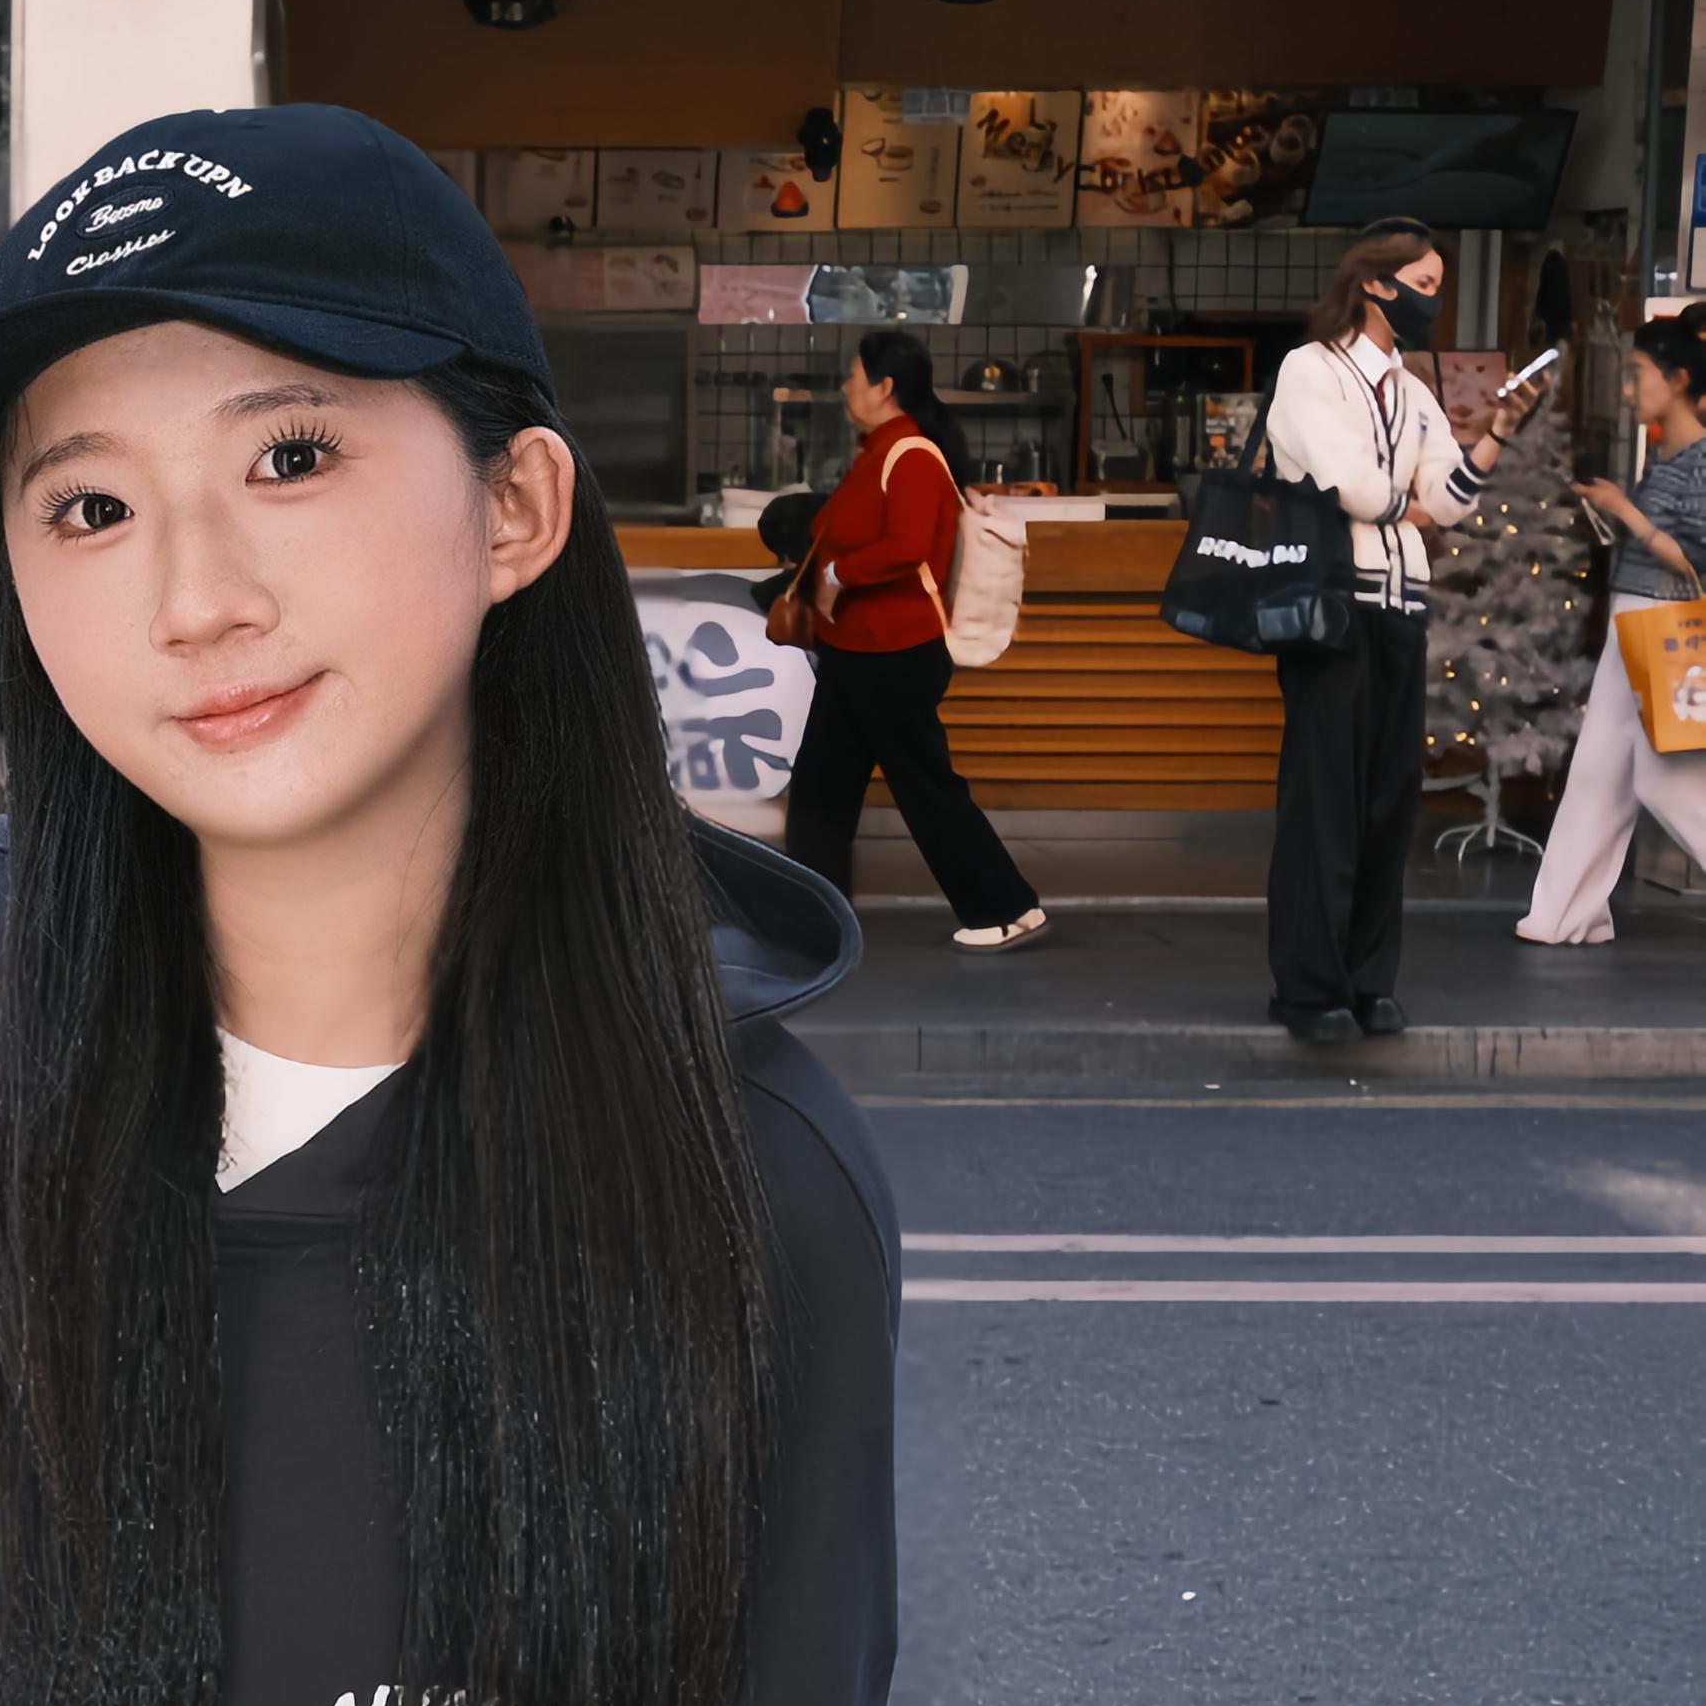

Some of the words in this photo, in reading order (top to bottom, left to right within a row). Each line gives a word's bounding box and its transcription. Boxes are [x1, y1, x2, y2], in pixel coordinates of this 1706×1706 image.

[28, 180, 92, 260] LOOK
[93, 149, 184, 188] BACK
[182, 154, 254, 199] UPN
